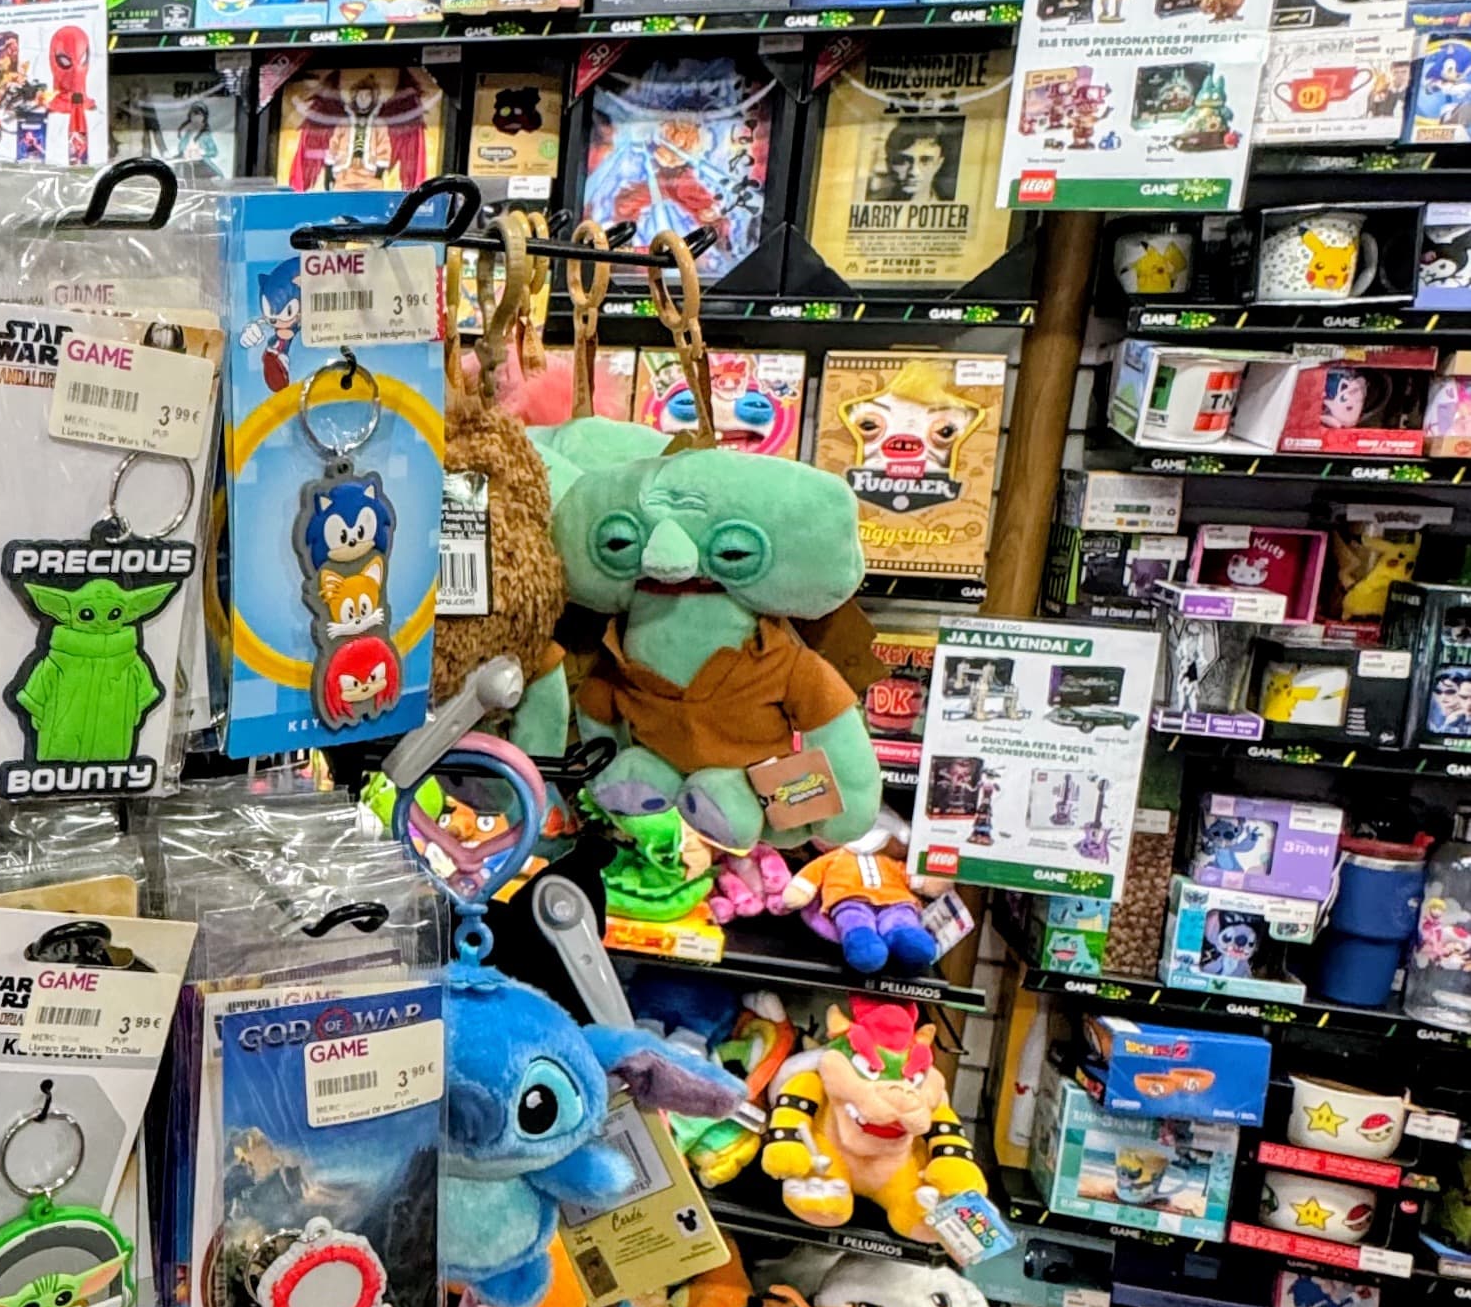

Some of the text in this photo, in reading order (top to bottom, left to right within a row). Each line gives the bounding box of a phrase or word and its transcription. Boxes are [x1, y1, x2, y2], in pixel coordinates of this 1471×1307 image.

[848, 204, 969, 229] HARRY POTTER
[304, 254, 365, 276] GAME
[67, 339, 134, 372] GAME
[12, 548, 194, 576] PRECIOUS
[945, 633, 969, 644] JA
[985, 636, 1006, 649] LA
[1006, 636, 1070, 654] VENDA!
[873, 685, 914, 714] DK
[7, 764, 155, 793] BOUNTY
[37, 970, 100, 993] GAME
[879, 980, 943, 1002] PELUIXOS
[238, 1017, 313, 1050] GOD
[352, 1003, 421, 1036] WAR
[309, 1038, 370, 1064] GAME
[842, 1236, 904, 1257] PELUIXOS
